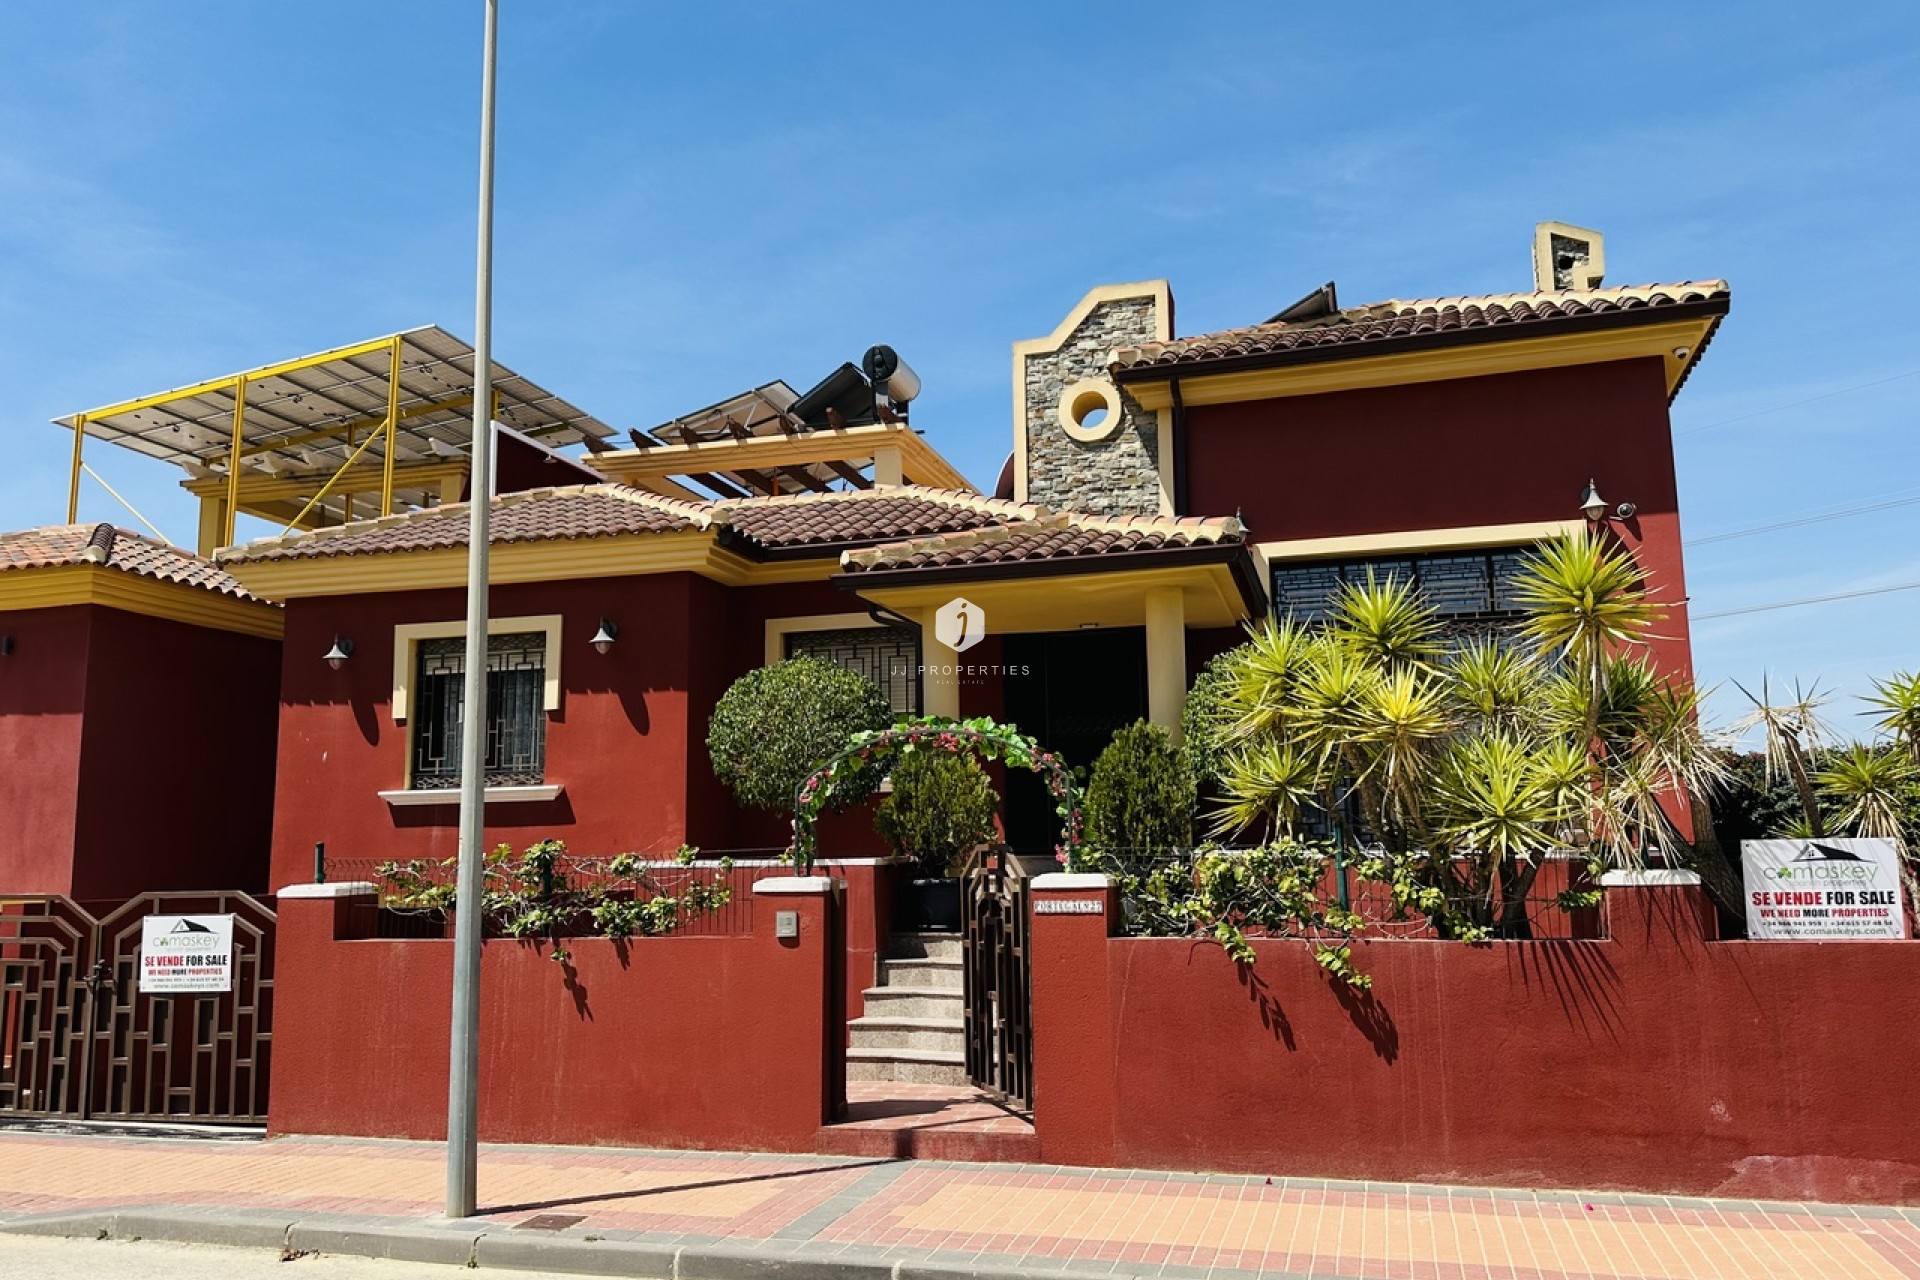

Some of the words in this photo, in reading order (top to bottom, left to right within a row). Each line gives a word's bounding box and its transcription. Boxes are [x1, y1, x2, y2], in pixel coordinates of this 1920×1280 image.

[1751, 891, 1771, 906] SE
[1773, 891, 1823, 906] VENDE
[1826, 891, 1856, 905] FOR
[1859, 890, 1896, 905] SALE
[1760, 909, 1776, 918] WE
[1777, 909, 1801, 918] NEED
[1802, 908, 1830, 918] MORE
[1831, 907, 1890, 917] PROPERTIES
[1773, 928, 1887, 937] www.comaskeys.com
[145, 956, 155, 967] SE
[157, 955, 184, 967] VENDE
[186, 955, 204, 966] FOR
[205, 954, 228, 966] SALE
[172, 968, 187, 976] MORE
[188, 967, 223, 975] PROPERTIES
